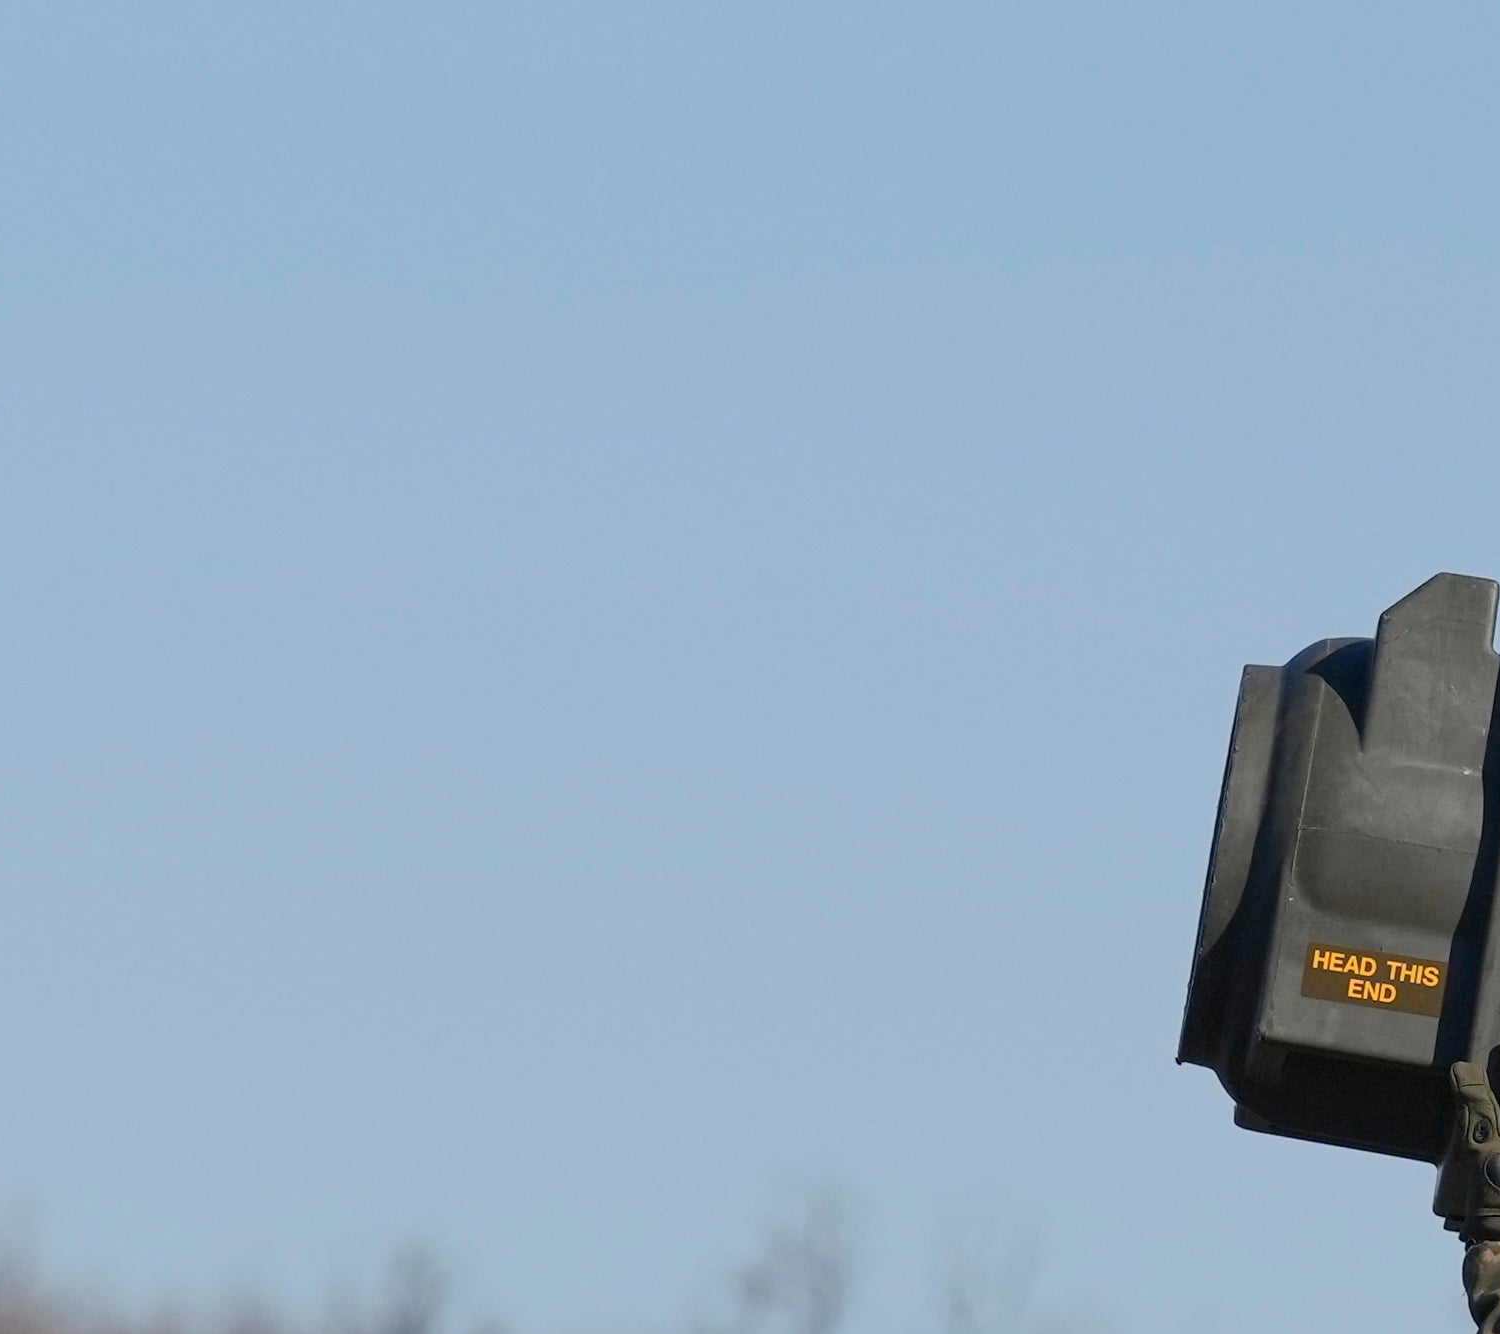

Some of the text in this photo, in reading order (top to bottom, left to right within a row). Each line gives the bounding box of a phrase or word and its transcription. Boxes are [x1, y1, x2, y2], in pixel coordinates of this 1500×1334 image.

[1312, 949, 1440, 987] HEAD THIS
[1347, 979, 1397, 1004] END
